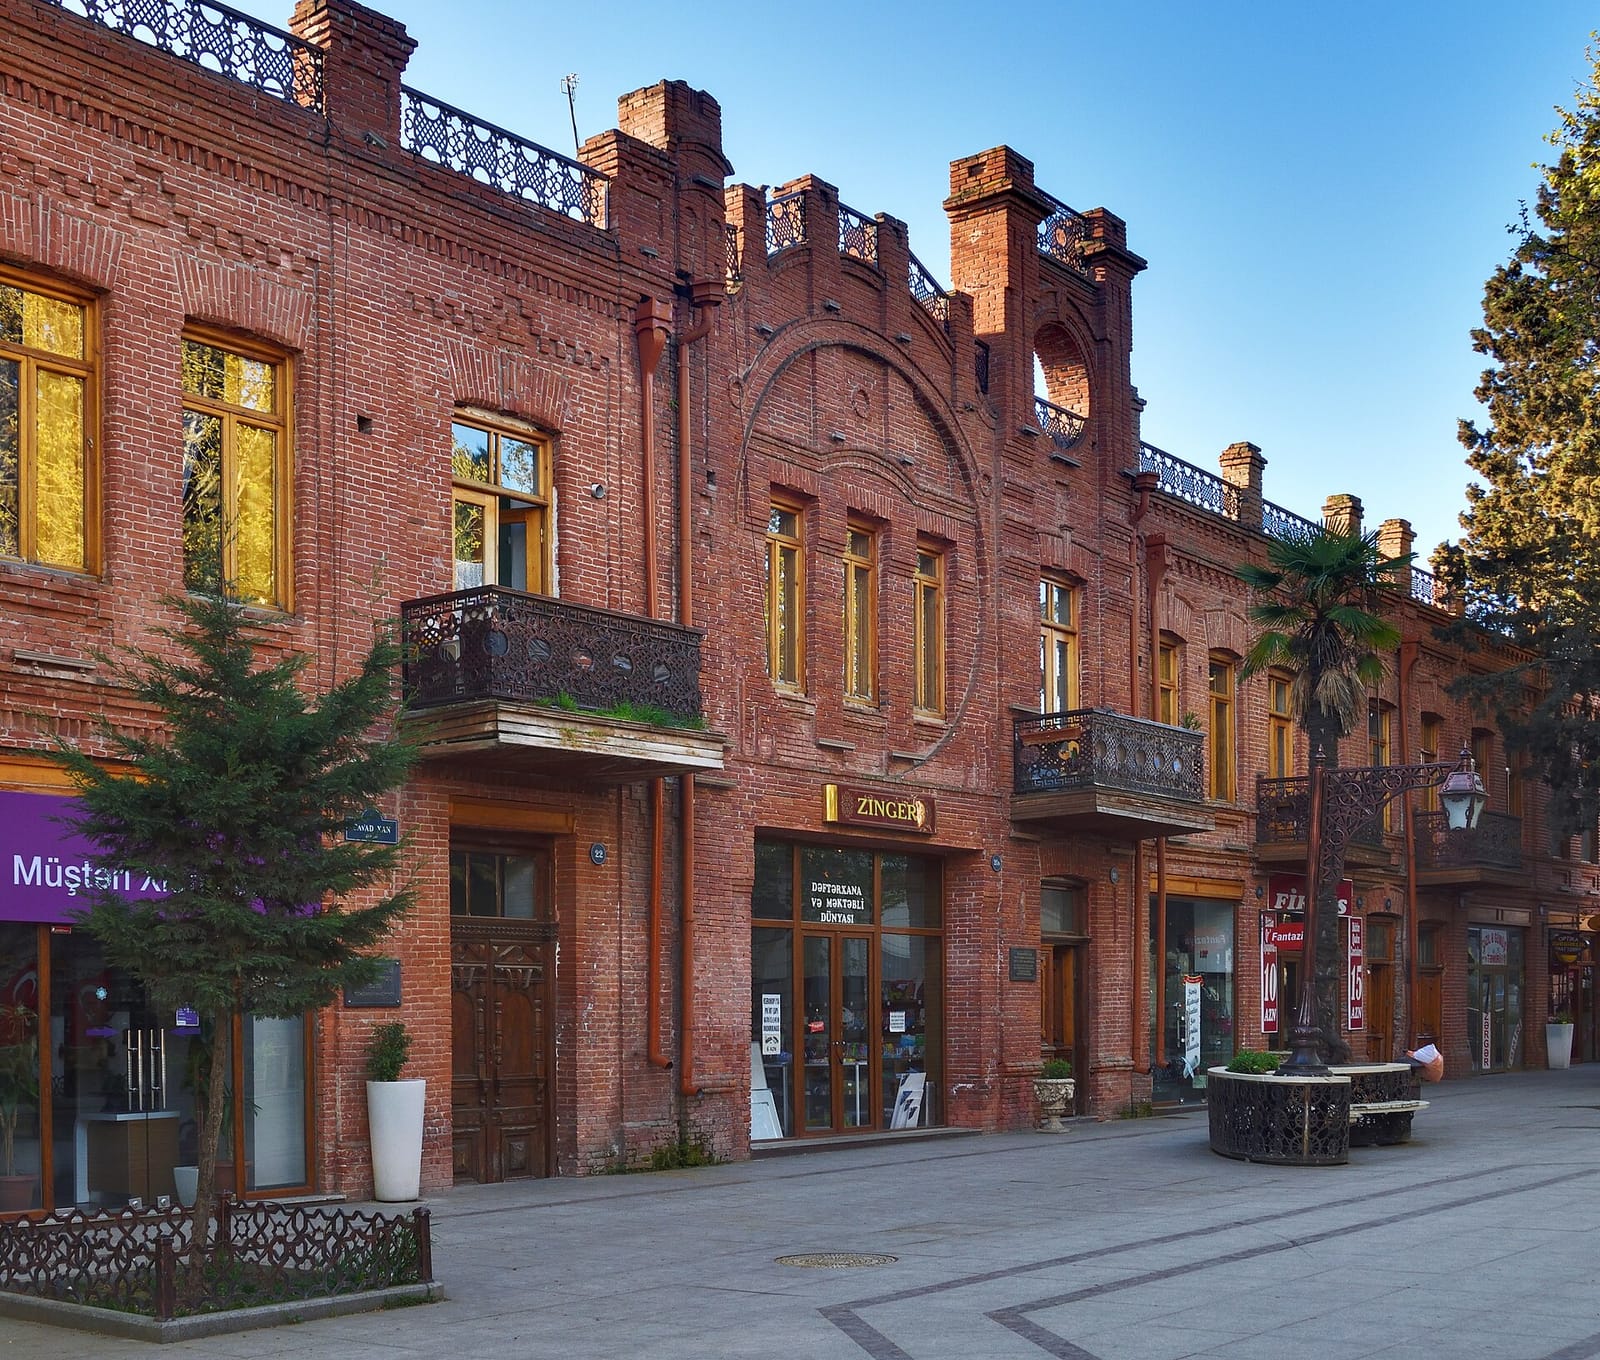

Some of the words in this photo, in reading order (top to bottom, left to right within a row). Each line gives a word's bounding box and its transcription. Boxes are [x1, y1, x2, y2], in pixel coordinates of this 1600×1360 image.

[820, 911, 854, 924] DÜNYASI
[1264, 963, 1277, 1002] 10
[1351, 965, 1362, 1001] 15
